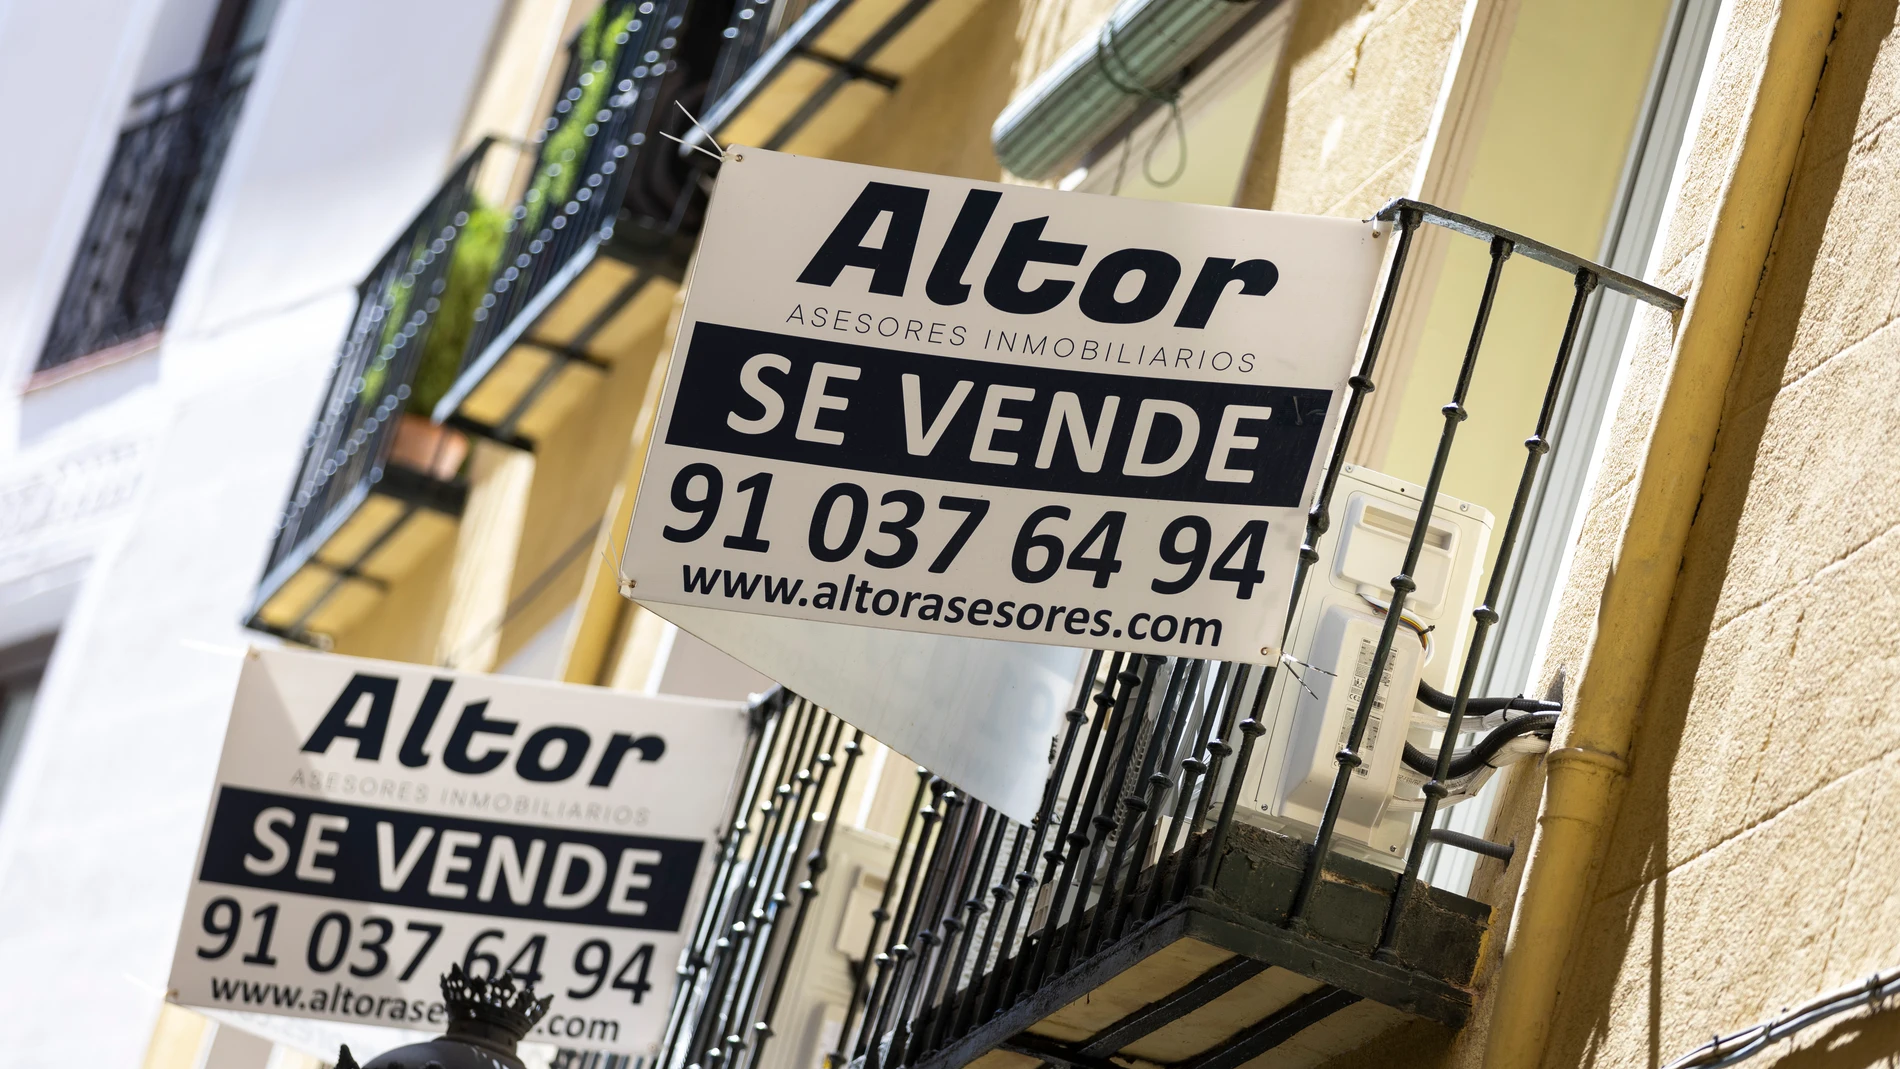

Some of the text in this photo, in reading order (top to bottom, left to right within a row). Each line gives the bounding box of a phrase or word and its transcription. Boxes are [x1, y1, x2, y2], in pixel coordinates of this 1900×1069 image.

[795, 180, 1279, 330] Altor
[785, 303, 1256, 374] ASESORES INMOBILIARIOS
[726, 353, 1273, 484] SE VENDE
[662, 462, 1271, 600] 91 037 64 94
[682, 564, 1223, 647] www.altorasesores.com
[300, 673, 666, 788] Altor
[290, 769, 651, 827] ASESORES INMOBILIARIOS
[243, 807, 663, 916] SE VENDE
[195, 896, 656, 1005] 91 037 64 94
[210, 976, 620, 1042] www.altorase.com
